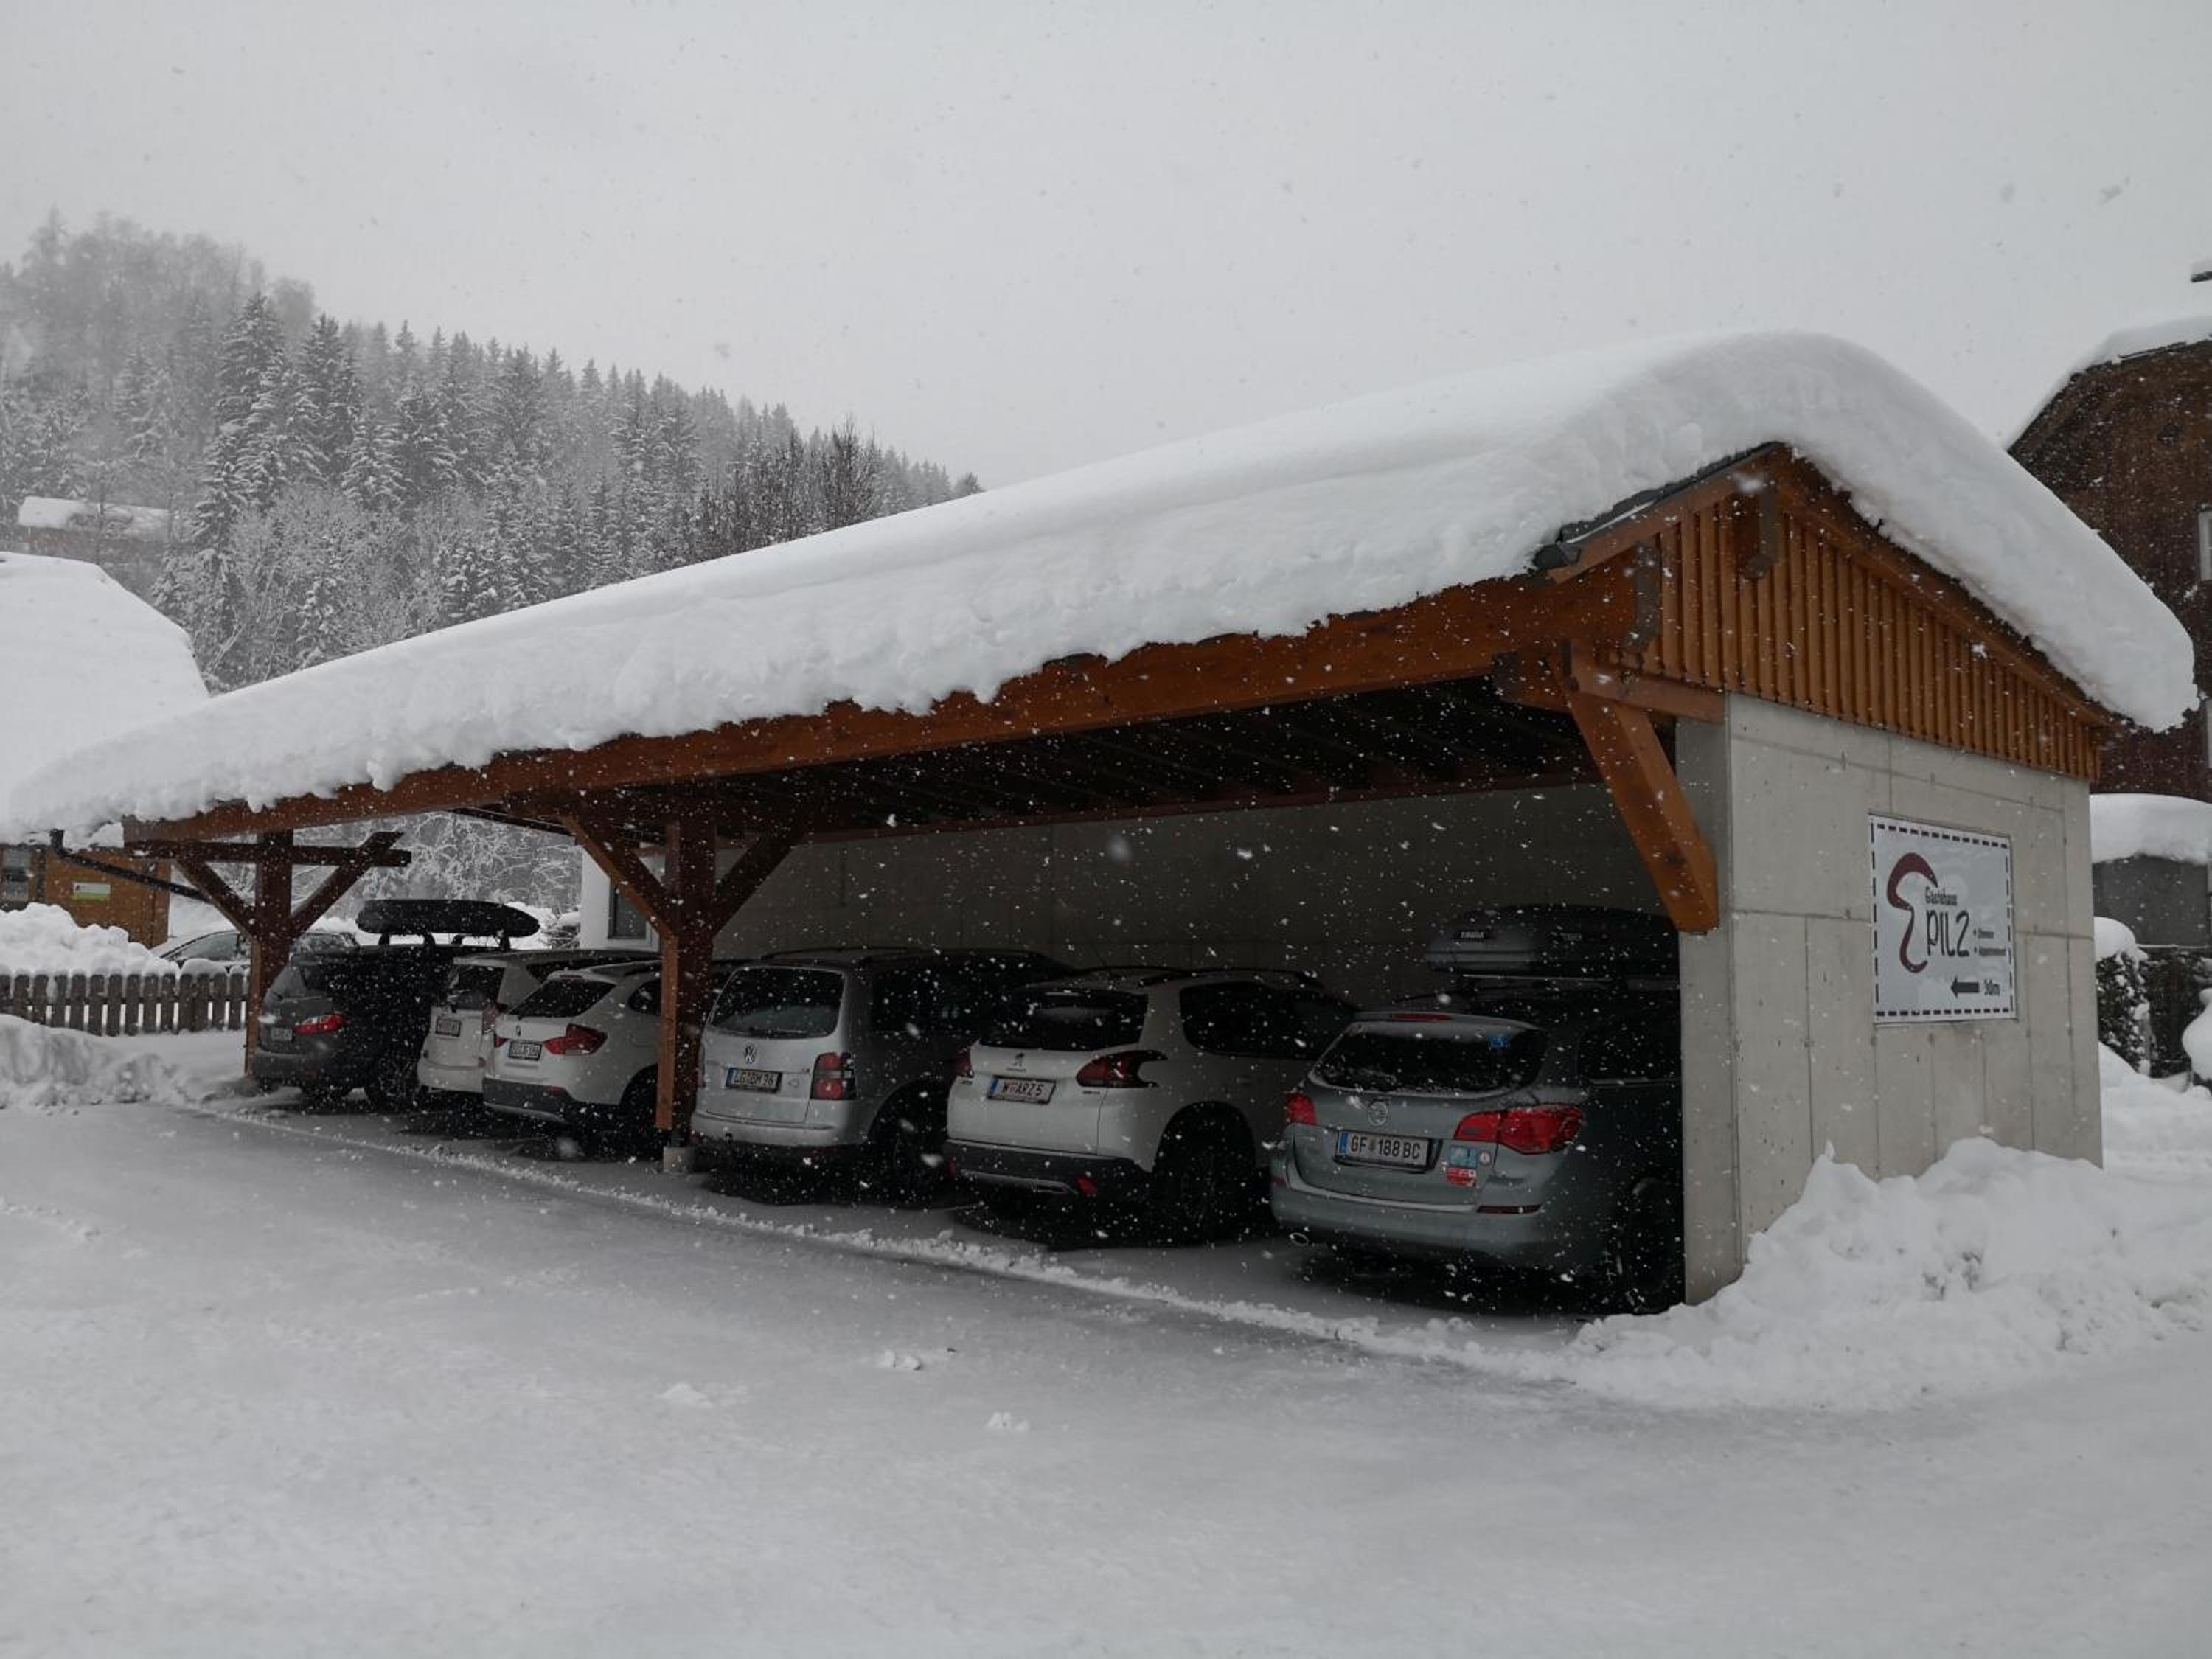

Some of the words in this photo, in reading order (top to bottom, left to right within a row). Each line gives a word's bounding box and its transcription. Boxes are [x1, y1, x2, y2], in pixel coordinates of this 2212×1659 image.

[1350, 1135, 1368, 1152] GF
[1378, 1138, 1401, 1157] 188
[1403, 1141, 1421, 1159] BC
